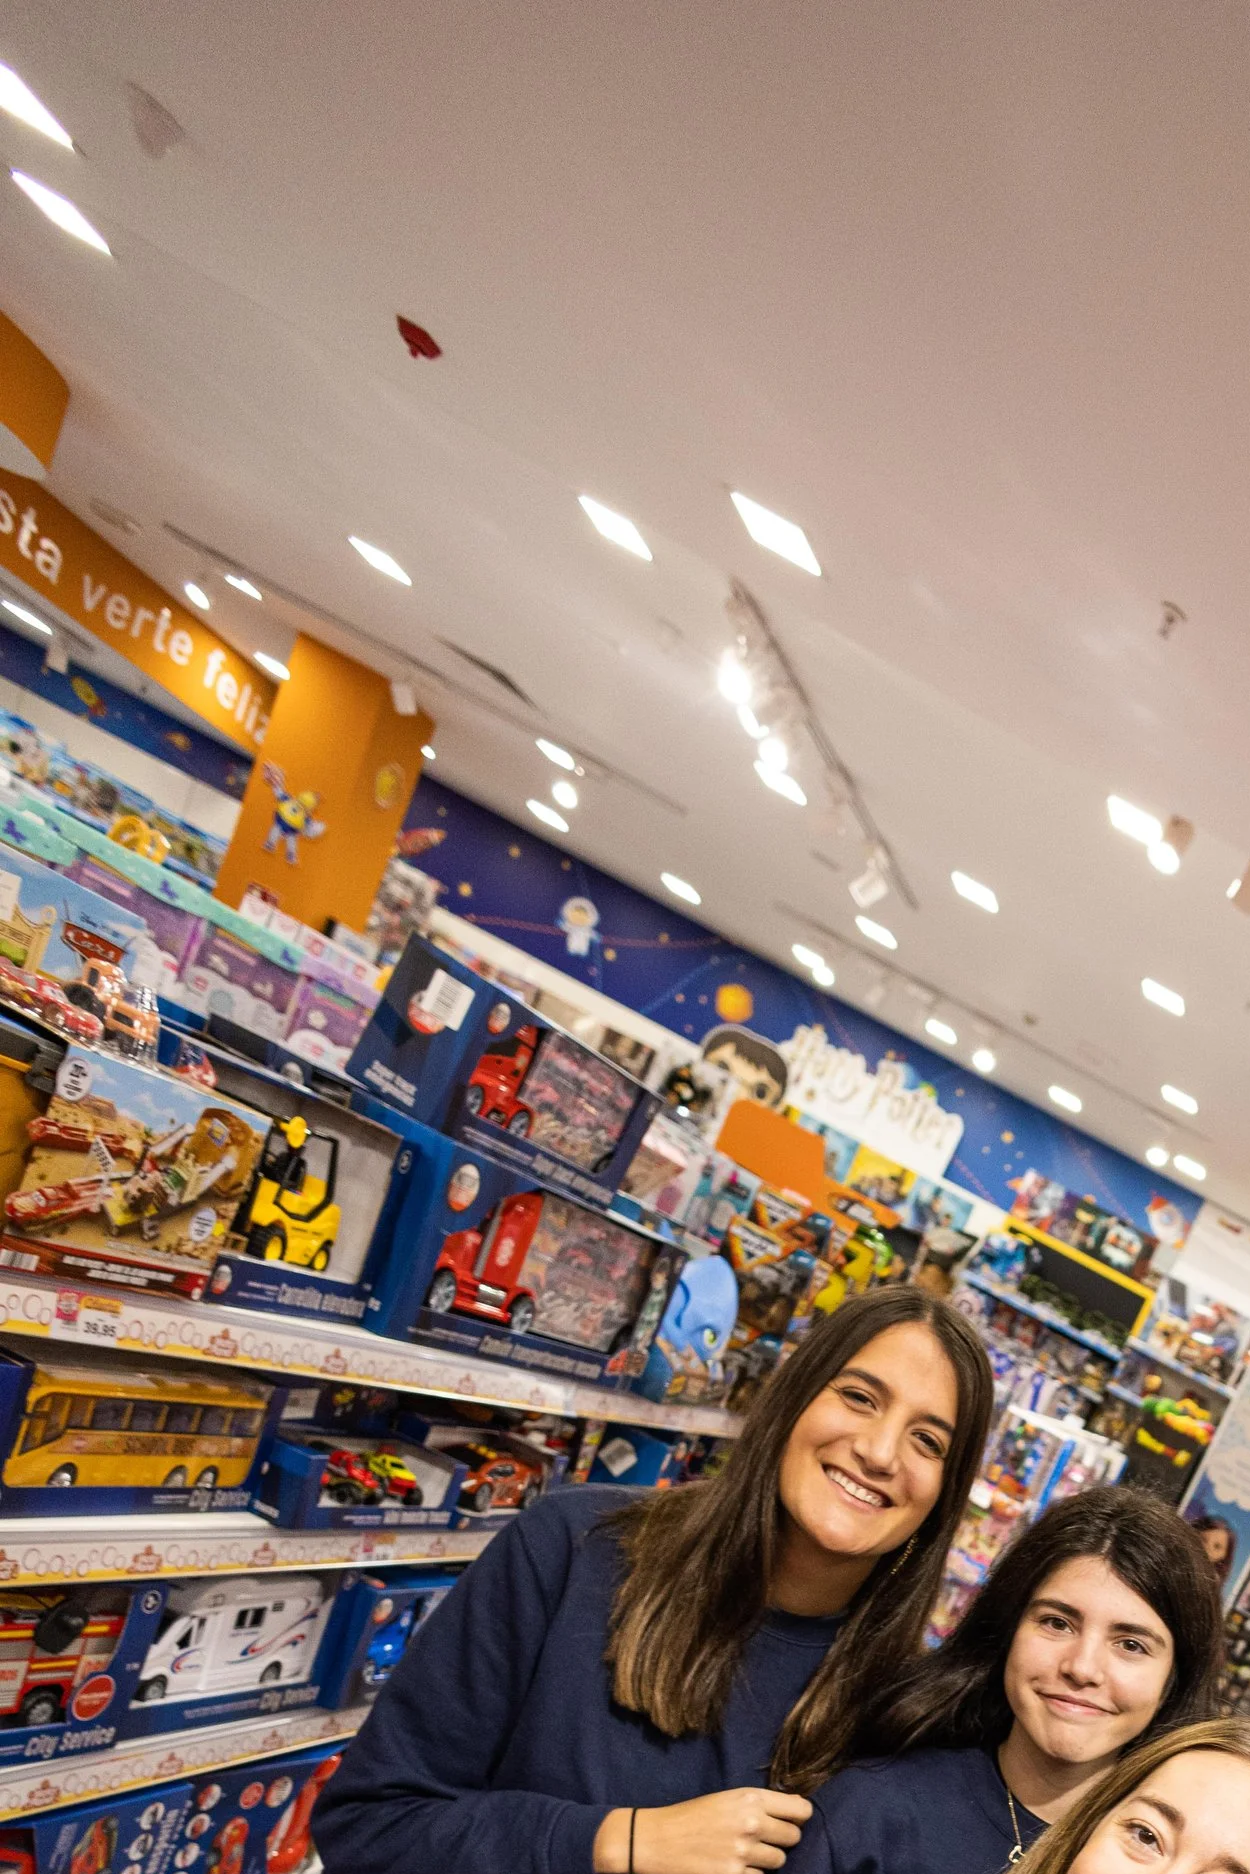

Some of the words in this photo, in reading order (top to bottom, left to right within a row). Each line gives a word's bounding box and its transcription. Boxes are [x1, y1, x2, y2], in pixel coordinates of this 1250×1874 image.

[81, 574, 195, 666] verte
[24, 1733, 60, 1759] City
[59, 1724, 117, 1752] Service
